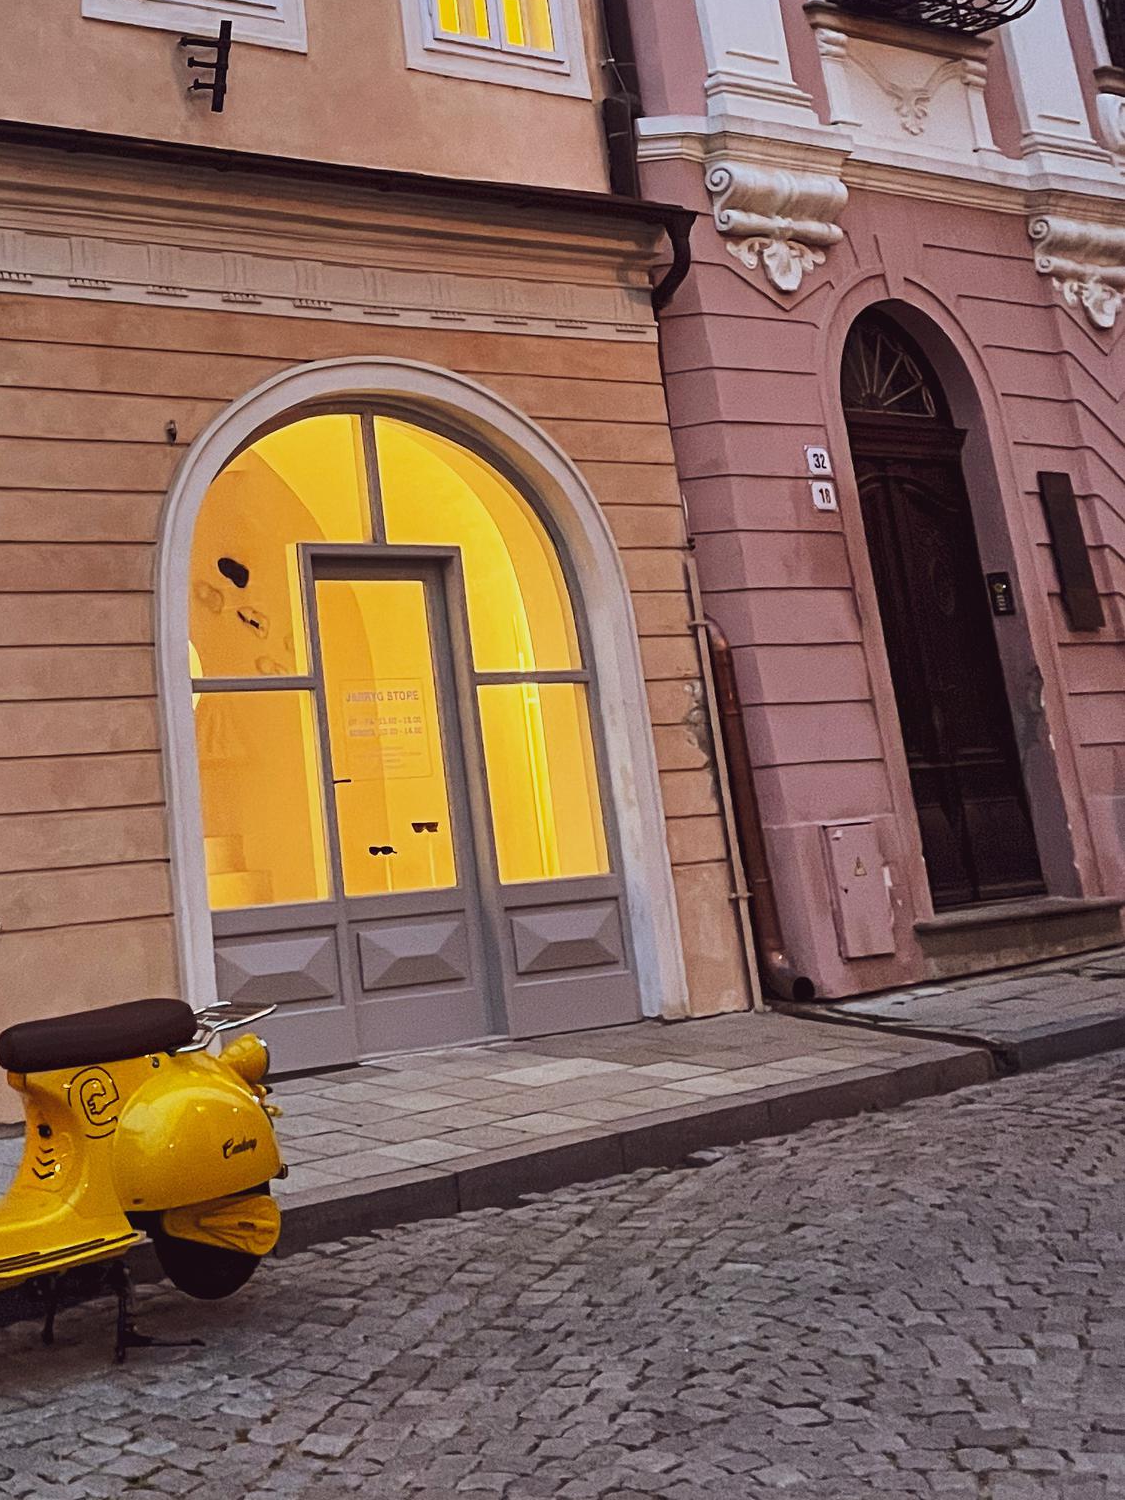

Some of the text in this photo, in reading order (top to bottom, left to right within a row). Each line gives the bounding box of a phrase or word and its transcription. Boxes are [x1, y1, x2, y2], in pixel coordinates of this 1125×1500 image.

[813, 453, 827, 469] 32
[819, 488, 832, 504] 18
[387, 690, 419, 701] STORE
